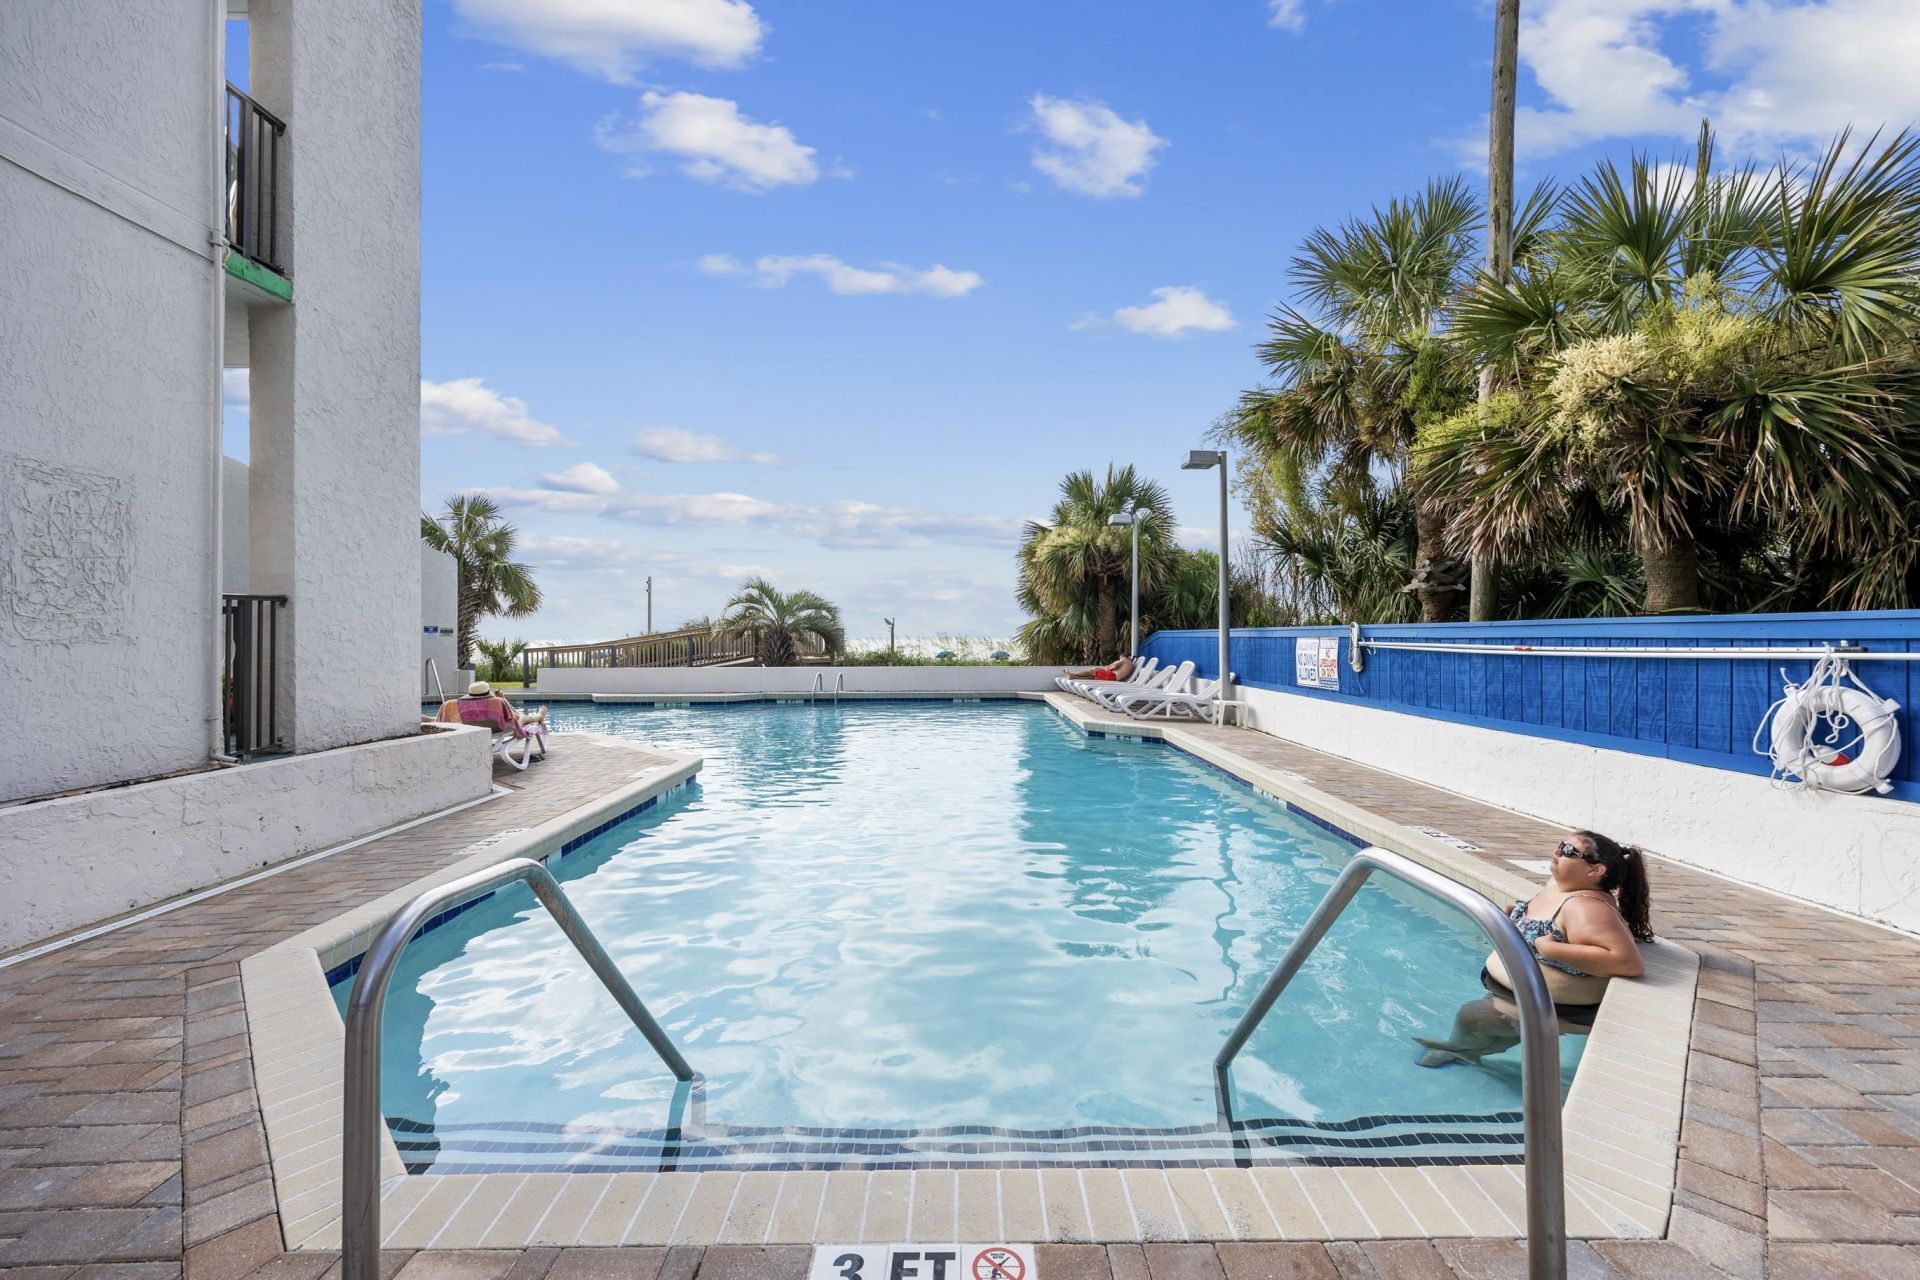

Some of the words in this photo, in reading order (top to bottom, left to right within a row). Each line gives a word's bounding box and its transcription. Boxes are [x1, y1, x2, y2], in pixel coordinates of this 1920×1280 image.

[1299, 667, 1317, 681] ALLOWED
[832, 1253, 865, 1280] 3
[890, 1252, 956, 1280] FT
